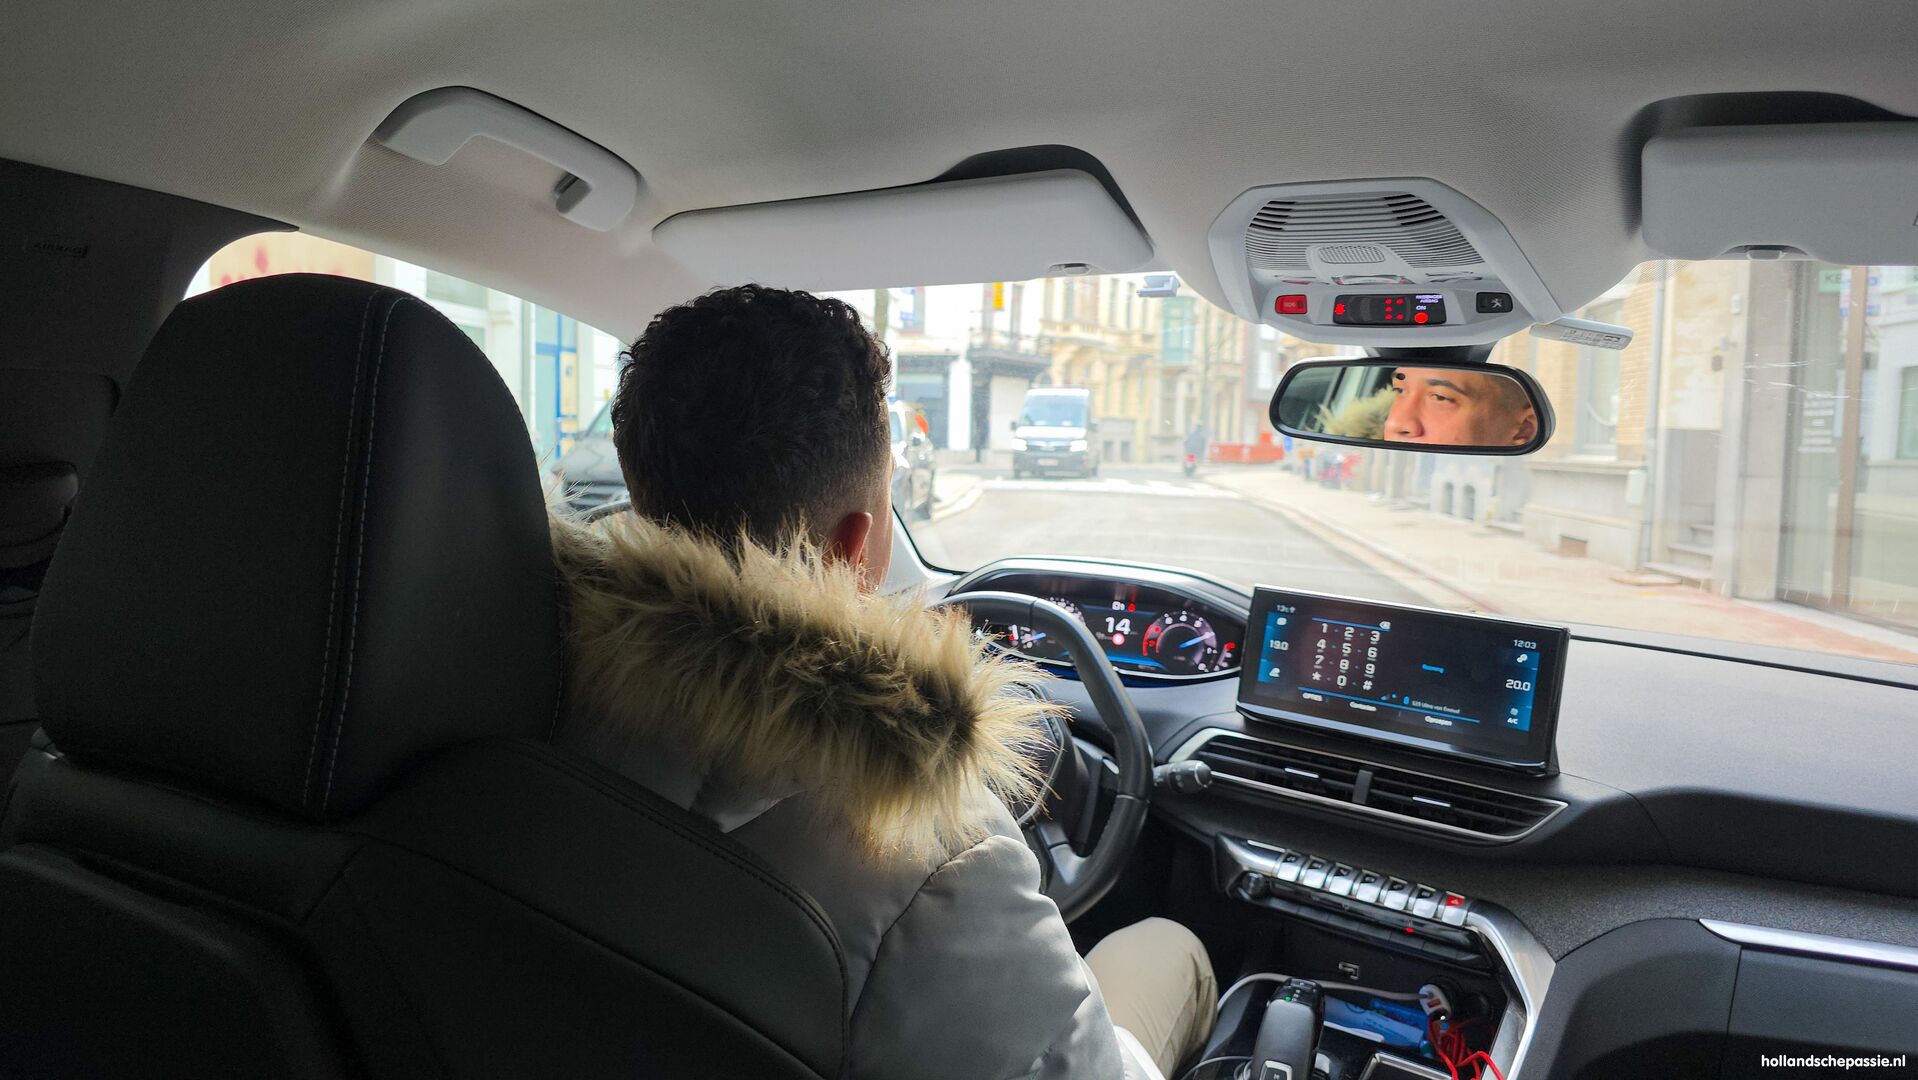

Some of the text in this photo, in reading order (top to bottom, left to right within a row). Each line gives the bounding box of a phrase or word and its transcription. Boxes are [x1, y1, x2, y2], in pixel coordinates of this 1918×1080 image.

[1105, 616, 1131, 635] 14
[1321, 623, 1329, 634] 1
[1344, 626, 1355, 638] 2
[1370, 630, 1381, 642] 3
[1316, 639, 1327, 650] 4
[1342, 642, 1352, 654] 5
[1513, 639, 1537, 650] 12:03
[1367, 646, 1378, 658] 6
[1315, 654, 1325, 665] 7
[1339, 659, 1350, 670] 8
[1365, 663, 1376, 675] 9
[1336, 675, 1347, 687] 0
[1505, 679, 1531, 692] 20.0
